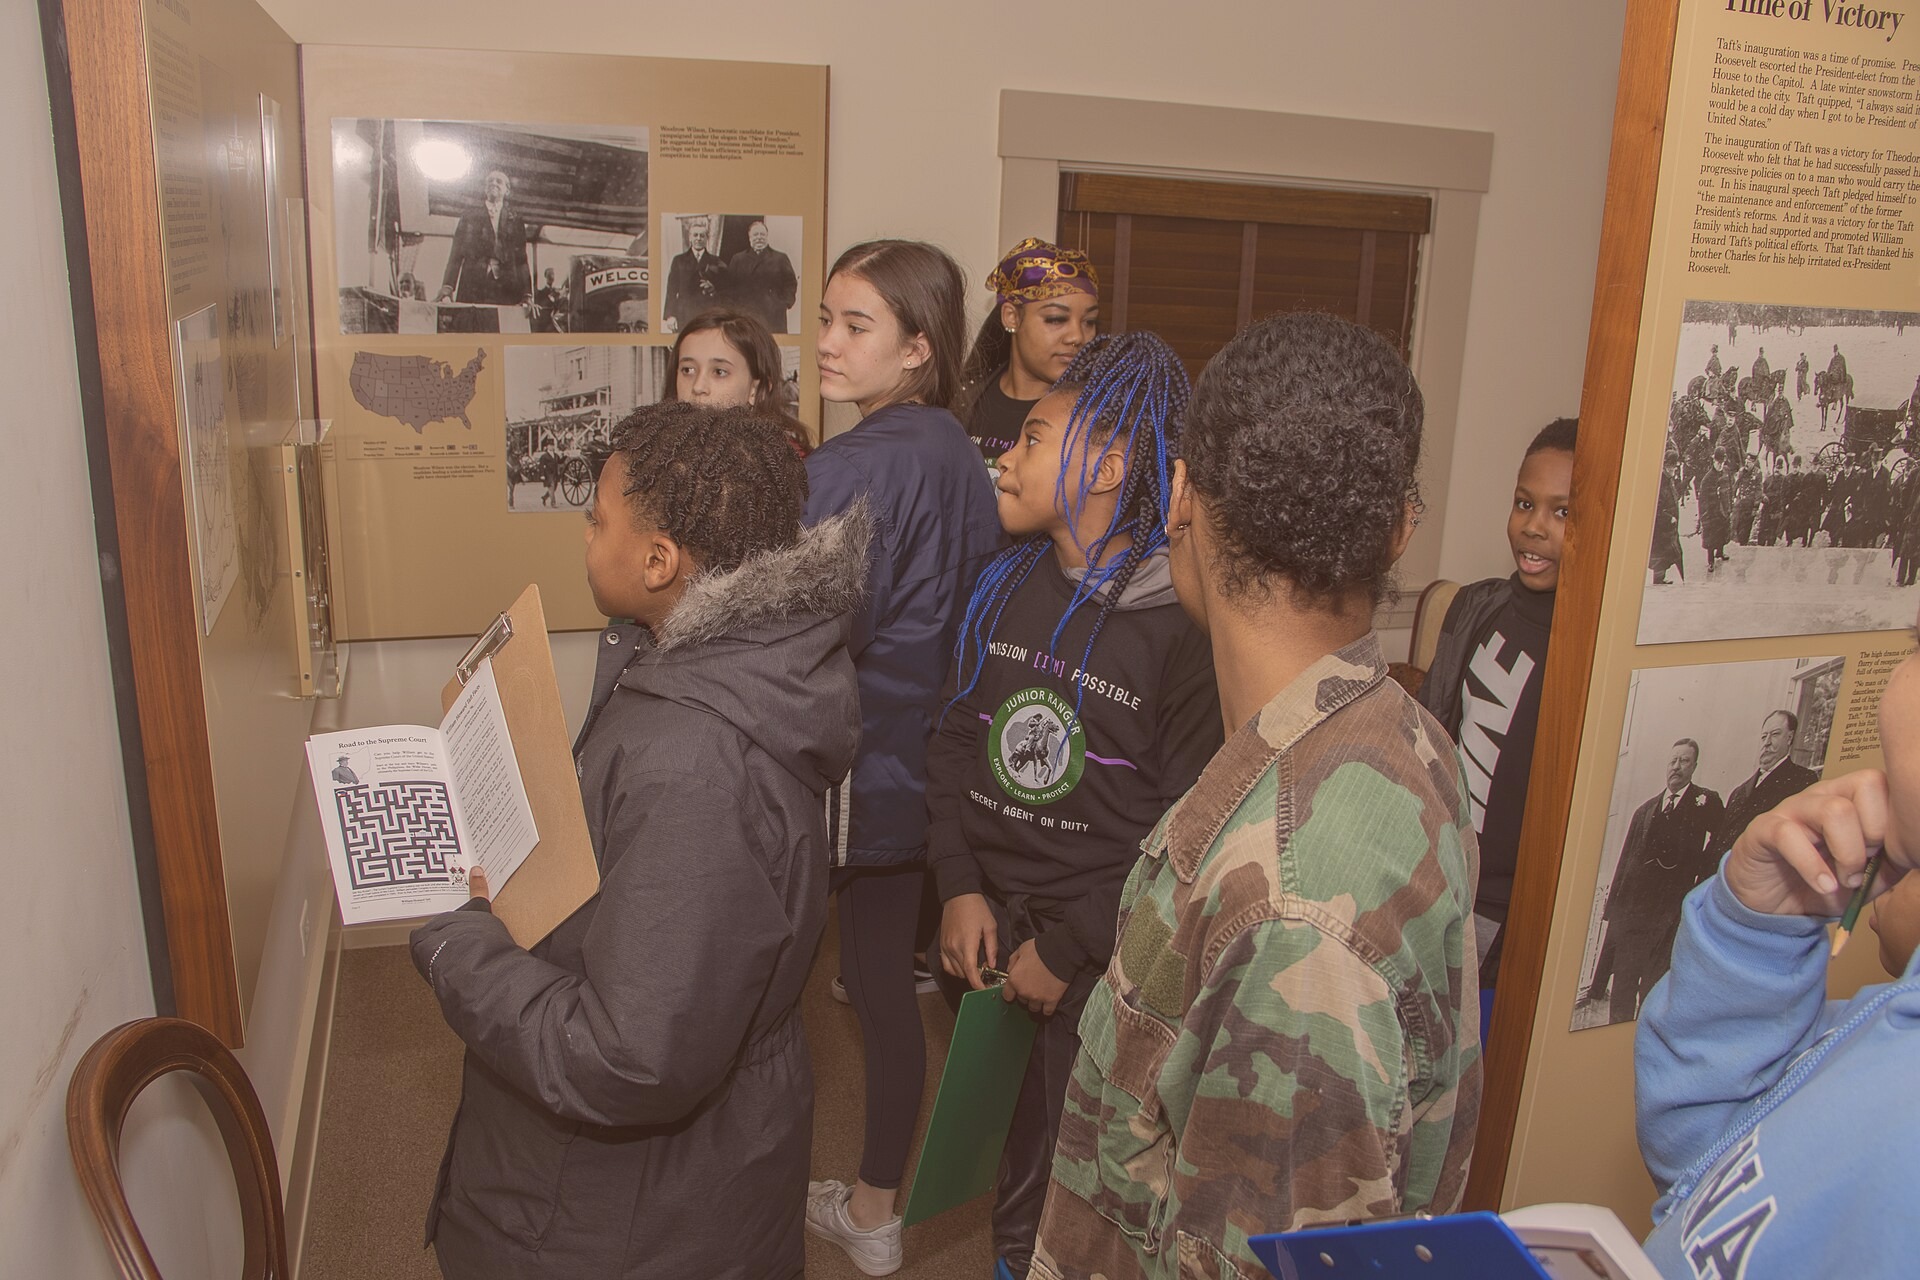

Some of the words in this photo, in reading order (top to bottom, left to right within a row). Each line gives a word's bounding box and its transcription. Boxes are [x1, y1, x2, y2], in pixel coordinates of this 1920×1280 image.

[1788, 0, 1813, 21] of
[1823, 0, 1905, 42] Victory
[1714, 53, 1756, 68] Roosevelt
[1759, 61, 1796, 72] escorted
[1798, 62, 1812, 74] the
[1814, 64, 1876, 81] President-elect
[1878, 71, 1899, 84] from
[1901, 73, 1915, 85] the
[1743, 42, 1799, 58] inauguration
[1802, 51, 1819, 60] was
[1820, 53, 1826, 61] a
[1829, 51, 1848, 64] time
[1850, 54, 1860, 65] of
[1860, 57, 1896, 69] promise.
[1712, 68, 1740, 81] House
[1743, 72, 1752, 82] to
[1754, 72, 1769, 84] the
[1771, 74, 1804, 89] Capitol.
[1809, 78, 1817, 90] A
[1819, 79, 1836, 92] late
[1838, 82, 1866, 95] winter
[1867, 88, 1912, 99] snowstorm
[1710, 82, 1755, 97] blanketed
[1757, 87, 1771, 99] the
[1795, 91, 1815, 104] Taft
[1816, 95, 1852, 110] quipped,
[1865, 99, 1893, 113] always
[1895, 103, 1913, 113] said
[1707, 111, 1736, 125] United
[1708, 98, 1735, 110] would
[1736, 99, 1748, 112] be
[1750, 104, 1756, 112] a
[1758, 103, 1777, 114] cold
[1778, 104, 1795, 118] day
[1797, 106, 1819, 119] when
[1821, 108, 1826, 120] I
[1827, 111, 1841, 122] got
[1843, 112, 1853, 122] to
[1855, 111, 1865, 123] be
[1867, 113, 1906, 127] President
[1908, 118, 1918, 128] of
[1704, 132, 1722, 144] The
[1724, 134, 1779, 150] inauguration
[1782, 140, 1792, 151] of
[1793, 140, 1812, 153] Taft
[1814, 146, 1830, 155] was
[1832, 147, 1837, 155] a
[1840, 146, 1869, 160] victory
[1871, 148, 1883, 159] for
[1702, 146, 1744, 161] Roosevelt
[1746, 151, 1764, 163] who
[1766, 152, 1780, 164] felt
[1783, 154, 1801, 166] that
[1802, 155, 1813, 167] he
[1815, 157, 1832, 169] had
[1833, 162, 1882, 175] successfully
[1882, 165, 1911, 176] passed
[1698, 177, 1714, 187] out.
[1720, 177, 1730, 189] In
[1732, 178, 1746, 190] his
[1748, 180, 1790, 195] inaugural
[1791, 185, 1819, 197] speech
[1822, 186, 1840, 198] Taft
[1841, 188, 1874, 202] pledged
[1875, 190, 1907, 203] himself
[1907, 194, 1916, 204] to
[1699, 164, 1748, 176] progressive
[1749, 166, 1782, 179] policies
[1784, 171, 1795, 180] on
[1797, 171, 1806, 181] to
[1808, 174, 1814, 182] a
[1816, 175, 1835, 184] man
[1837, 173, 1854, 185] who
[1856, 176, 1881, 187] would
[1882, 180, 1905, 191] carry
[1717, 193, 1773, 206] maintenance
[1774, 197, 1792, 208] and
[1849, 203, 1859, 213] of
[1860, 203, 1873, 214] the
[1875, 204, 1902, 217] former
[1692, 218, 1721, 233] family
[1723, 221, 1748, 233] which
[1750, 222, 1768, 234] had
[1769, 227, 1811, 238] supported
[1812, 228, 1829, 239] and
[1830, 231, 1869, 242] promoted
[1871, 231, 1903, 244] William
[1743, 208, 1777, 221] reforms.
[1782, 211, 1801, 223] And
[1802, 212, 1809, 223] it
[1811, 216, 1827, 225] was
[1828, 217, 1834, 225] a
[1836, 215, 1865, 230] victory
[1866, 217, 1879, 229] for
[1880, 218, 1894, 230] the
[1896, 219, 1914, 231] Taft
[1689, 246, 1722, 259] brother
[1724, 248, 1756, 261] Charles
[1757, 251, 1771, 262] for
[1772, 251, 1785, 263] his
[1787, 252, 1805, 267] help
[1807, 254, 1841, 267] irritated
[1842, 257, 1890, 270] ex-President
[1691, 233, 1726, 245] Howard
[1753, 237, 1788, 251] political
[1790, 240, 1818, 252] efforts.
[1823, 242, 1844, 253] That
[1846, 243, 1866, 255] Taft
[1866, 245, 1900, 257] thanked
[1901, 247, 1914, 258] his
[1687, 260, 1730, 274] Roosevelt.
[989, 642, 1028, 662] MISION
[1070, 668, 1141, 711] POSSIBLE
[1006, 690, 1045, 713] JUNIOR
[338, 741, 357, 749] Road
[1458, 631, 1536, 834] IKE
[993, 757, 1010, 788] EXPLORE
[1014, 788, 1035, 801] LEARN
[1042, 781, 1070, 800] PROTECT
[969, 790, 998, 811] SECRET
[1002, 805, 1034, 823] AGENT
[1040, 816, 1054, 828] ON
[1060, 820, 1089, 832] DUTY
